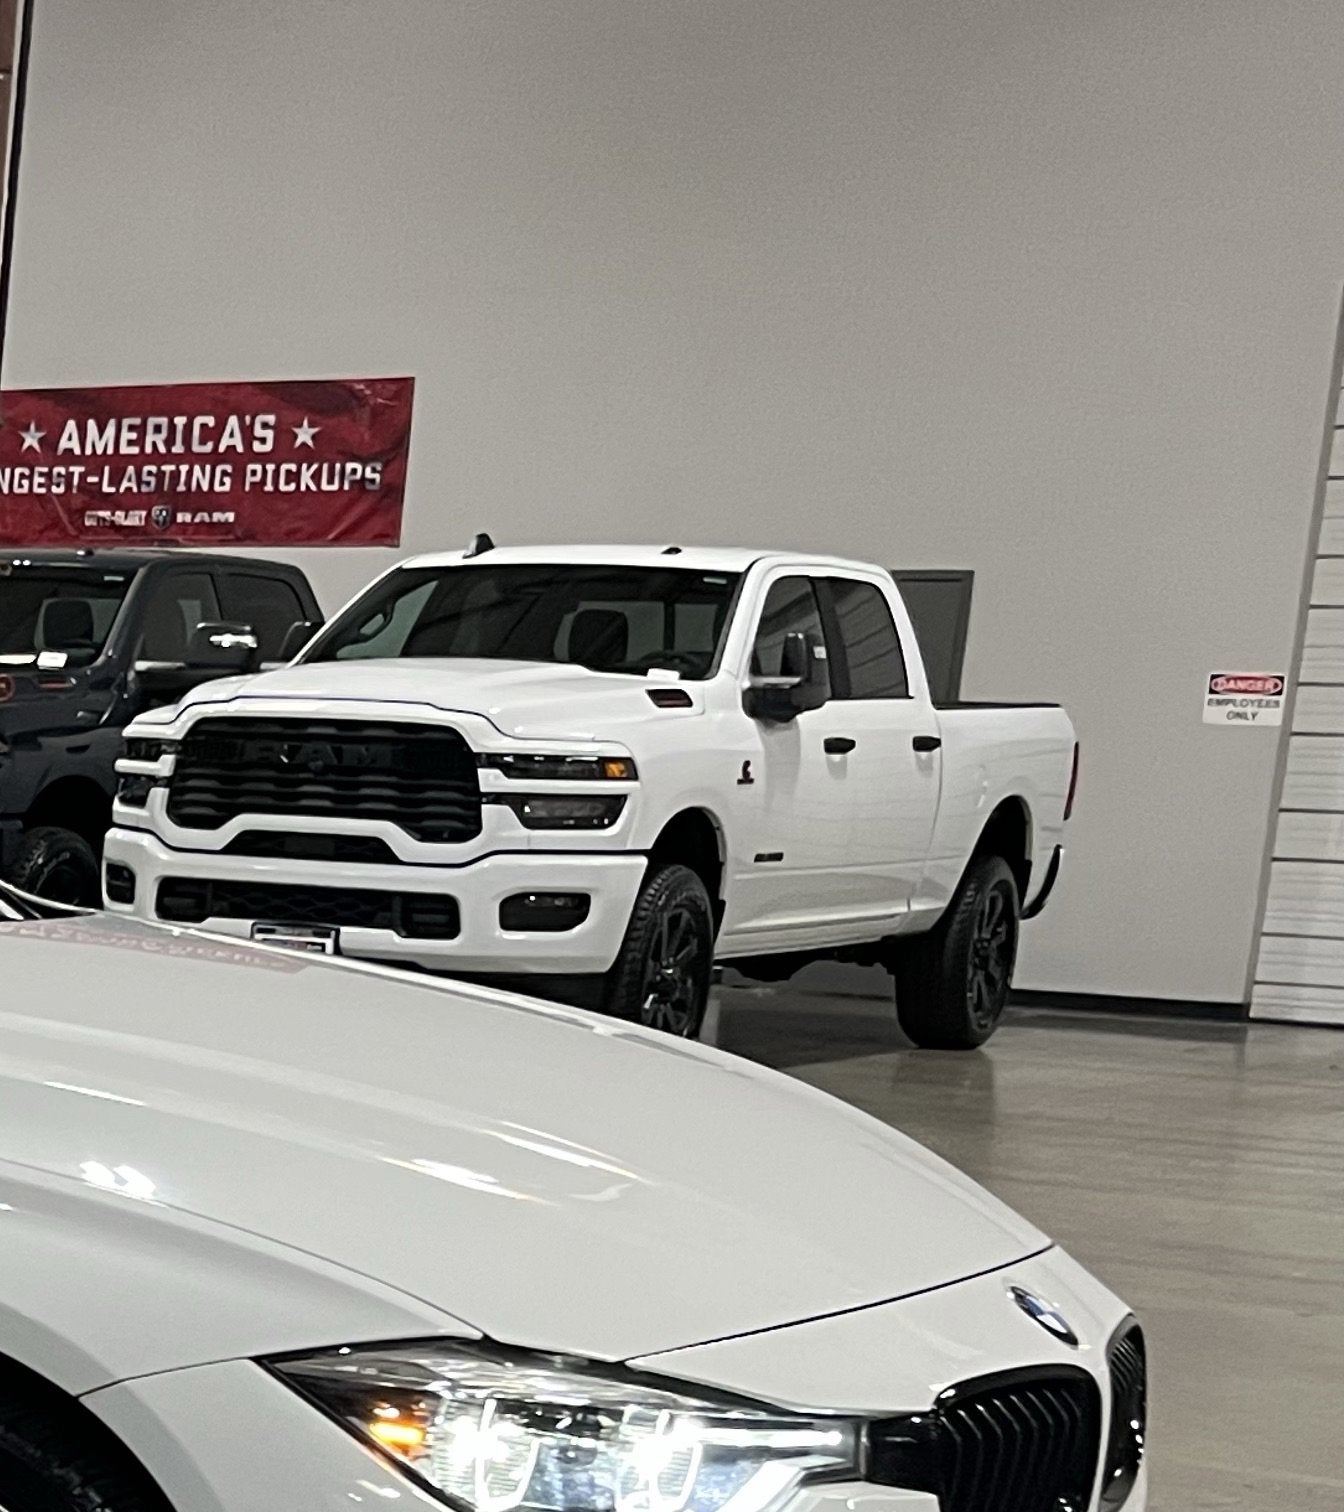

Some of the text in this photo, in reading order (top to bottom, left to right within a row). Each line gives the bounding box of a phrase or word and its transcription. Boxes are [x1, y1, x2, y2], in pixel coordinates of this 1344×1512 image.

[56, 413, 277, 457] AMERICA'S
[244, 461, 382, 493] PICKUPS
[176, 511, 235, 523] RAM
[1217, 678, 1275, 692] DANGER
[1207, 698, 1280, 709] EMPLOYEES
[1226, 710, 1258, 721] ONLY
